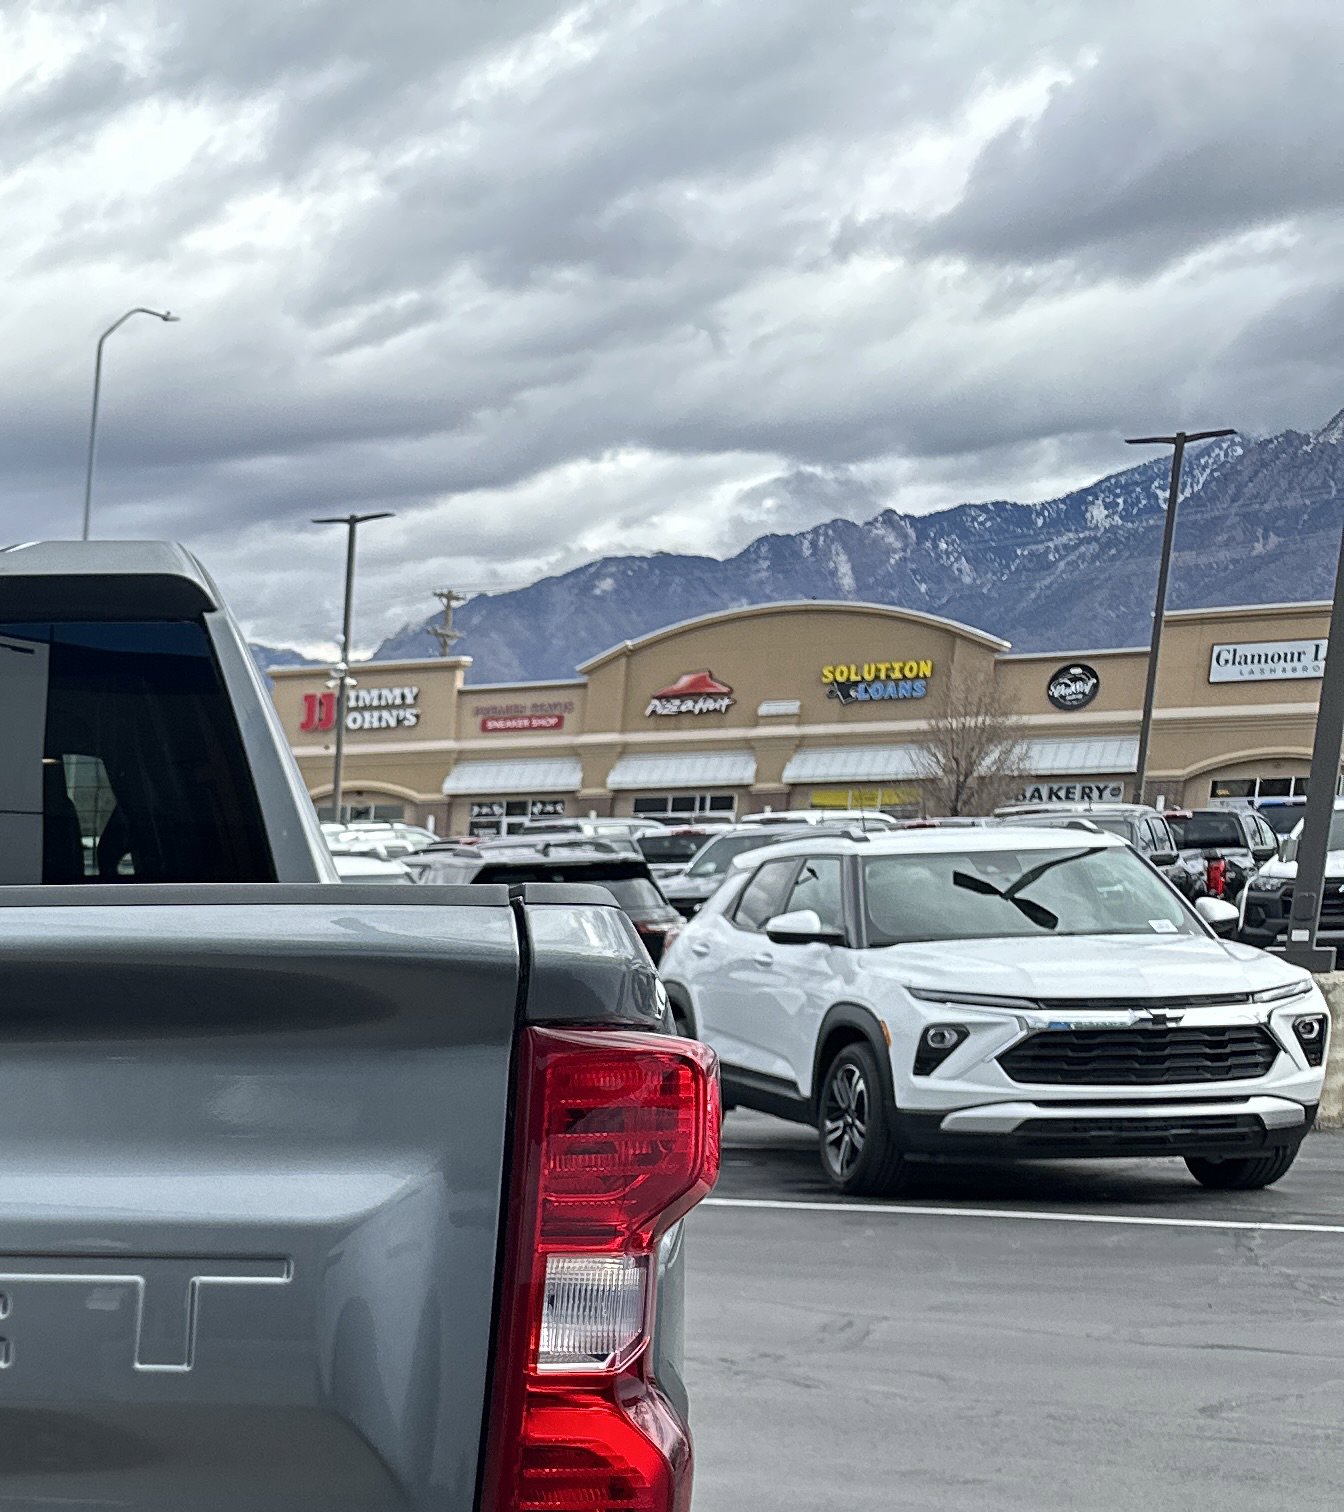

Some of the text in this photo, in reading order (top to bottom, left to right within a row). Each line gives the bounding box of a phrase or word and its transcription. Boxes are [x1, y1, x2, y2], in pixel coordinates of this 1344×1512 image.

[1216, 647, 1307, 668] Glamour
[821, 659, 933, 684] SOLUTION
[856, 679, 928, 701] LOANS
[486, 716, 559, 730] SNEAKER SHOP
